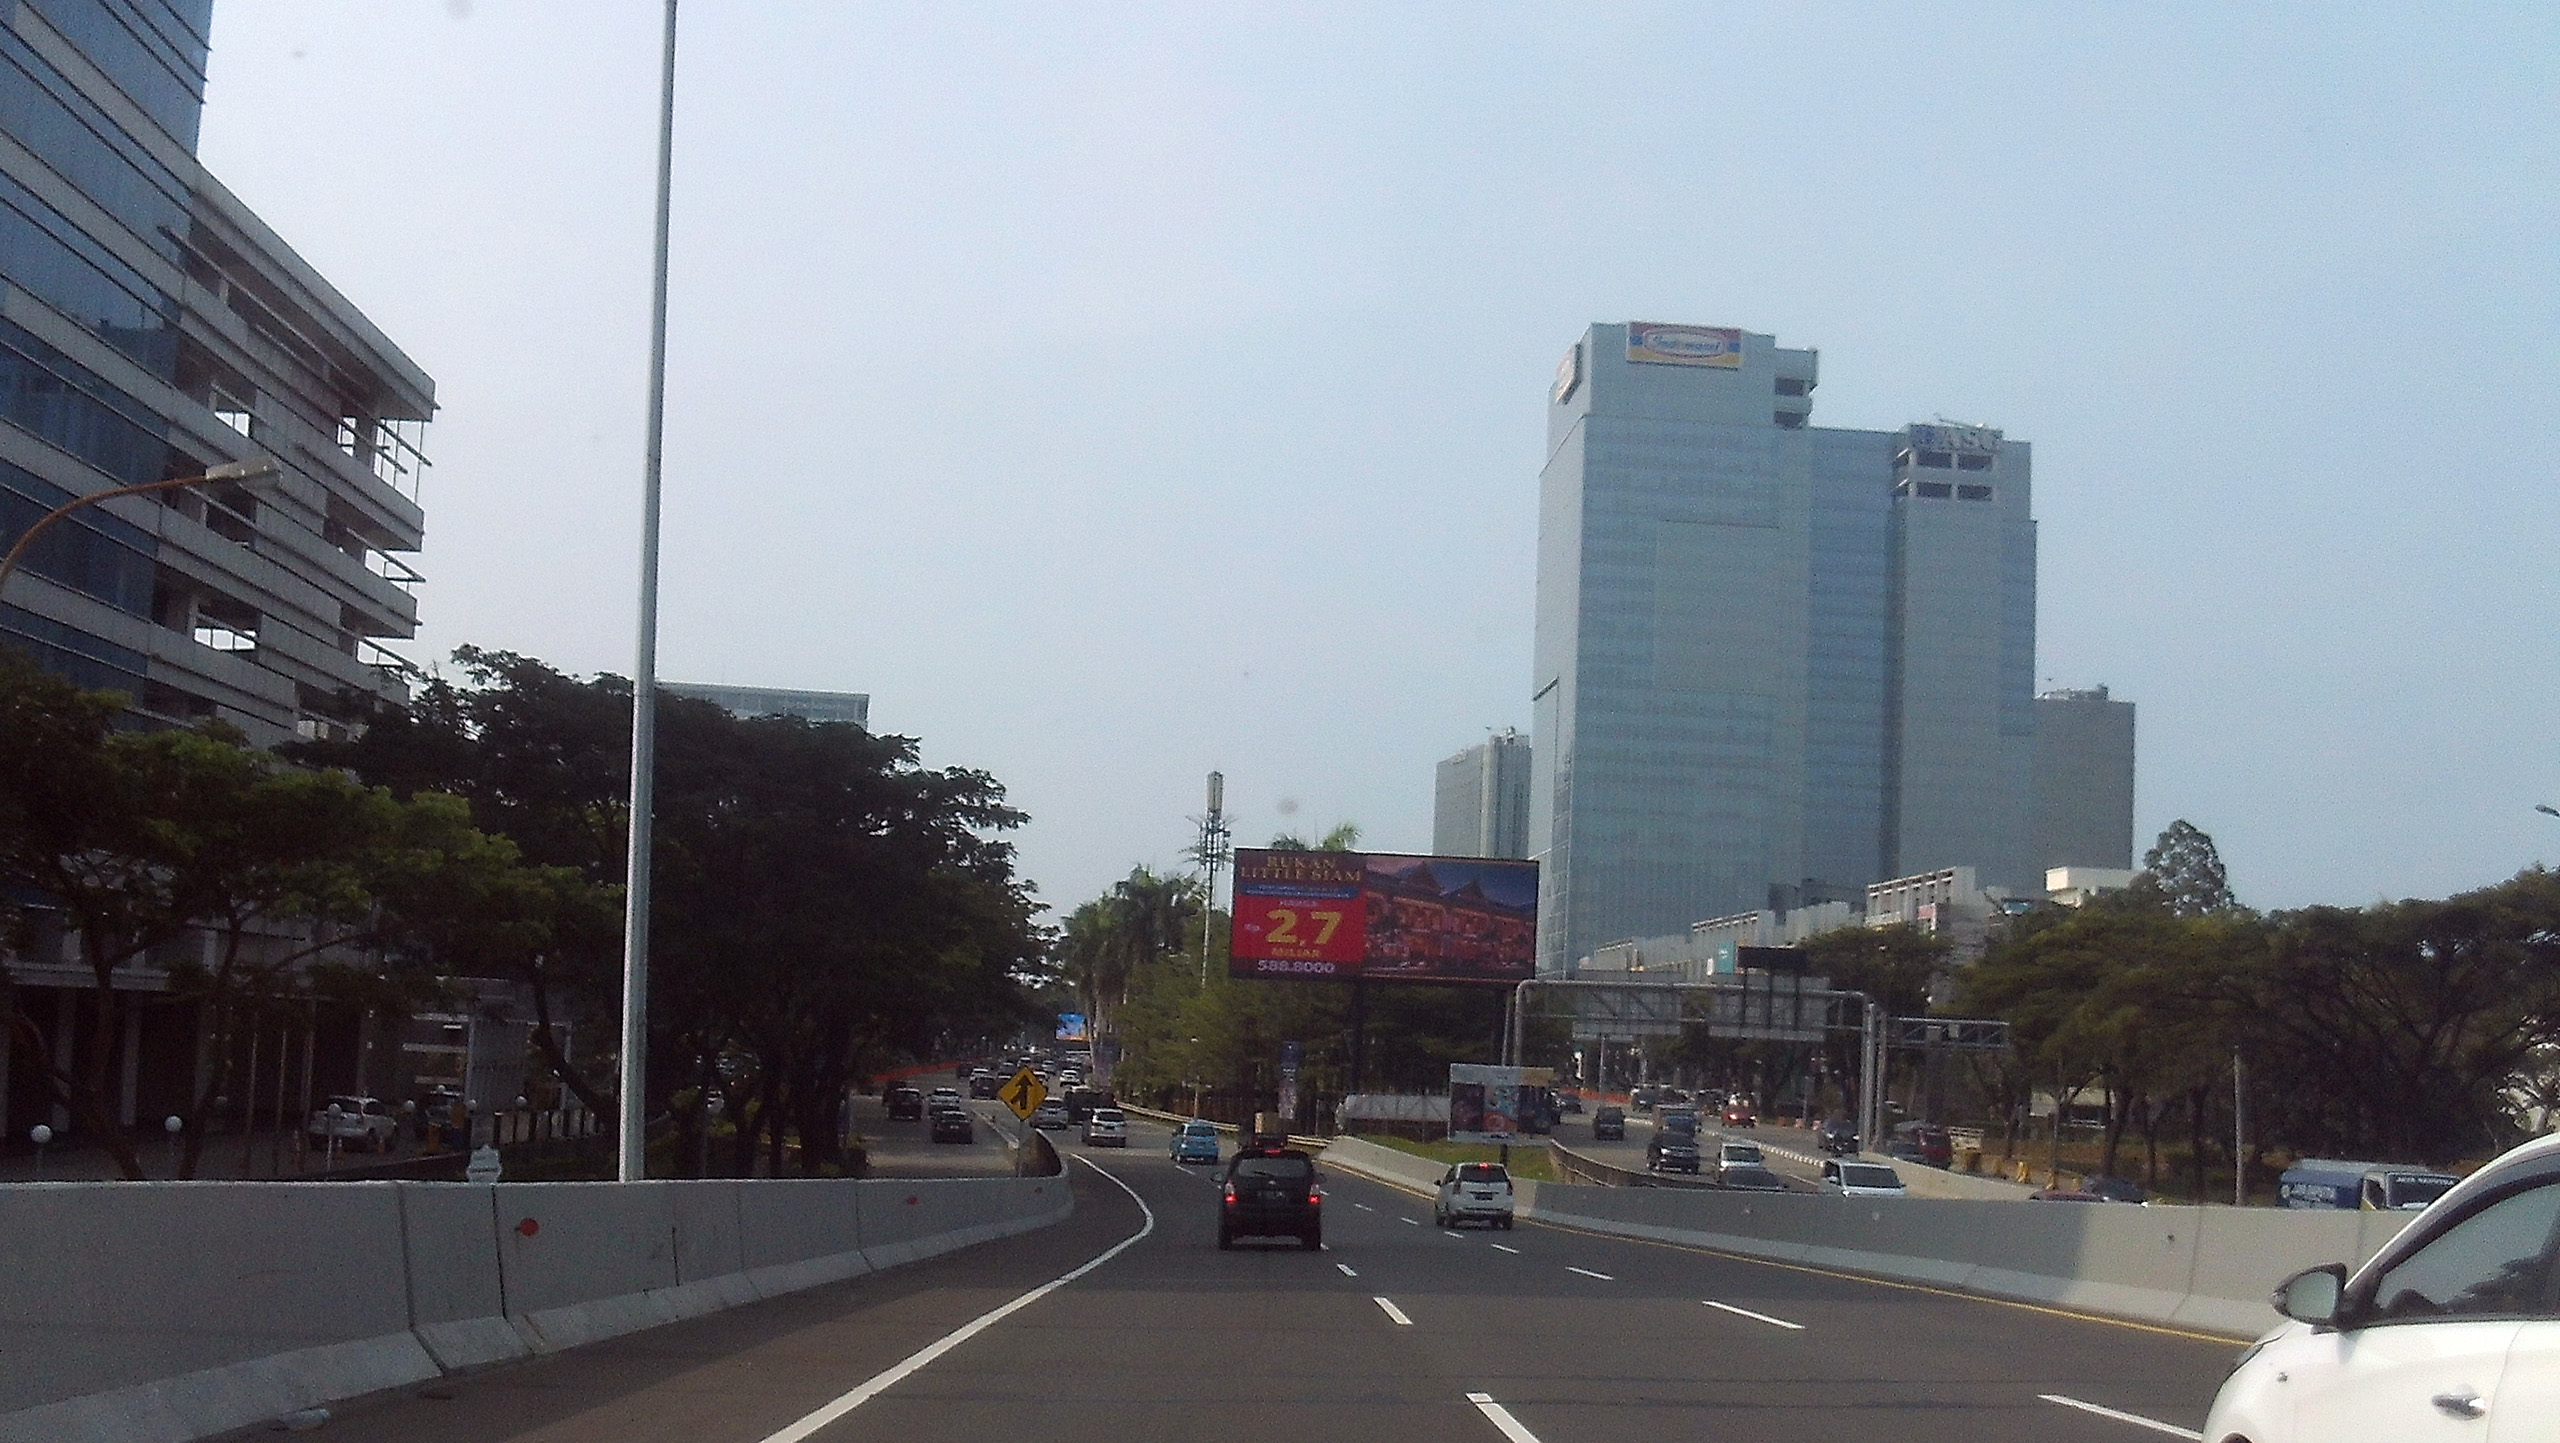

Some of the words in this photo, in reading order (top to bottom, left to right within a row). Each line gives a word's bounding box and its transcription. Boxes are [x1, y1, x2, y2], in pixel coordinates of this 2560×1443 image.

[1241, 866, 1304, 880] LITTLE
[1311, 869, 1361, 882] SIAM
[1257, 959, 1336, 974] 588.8000
